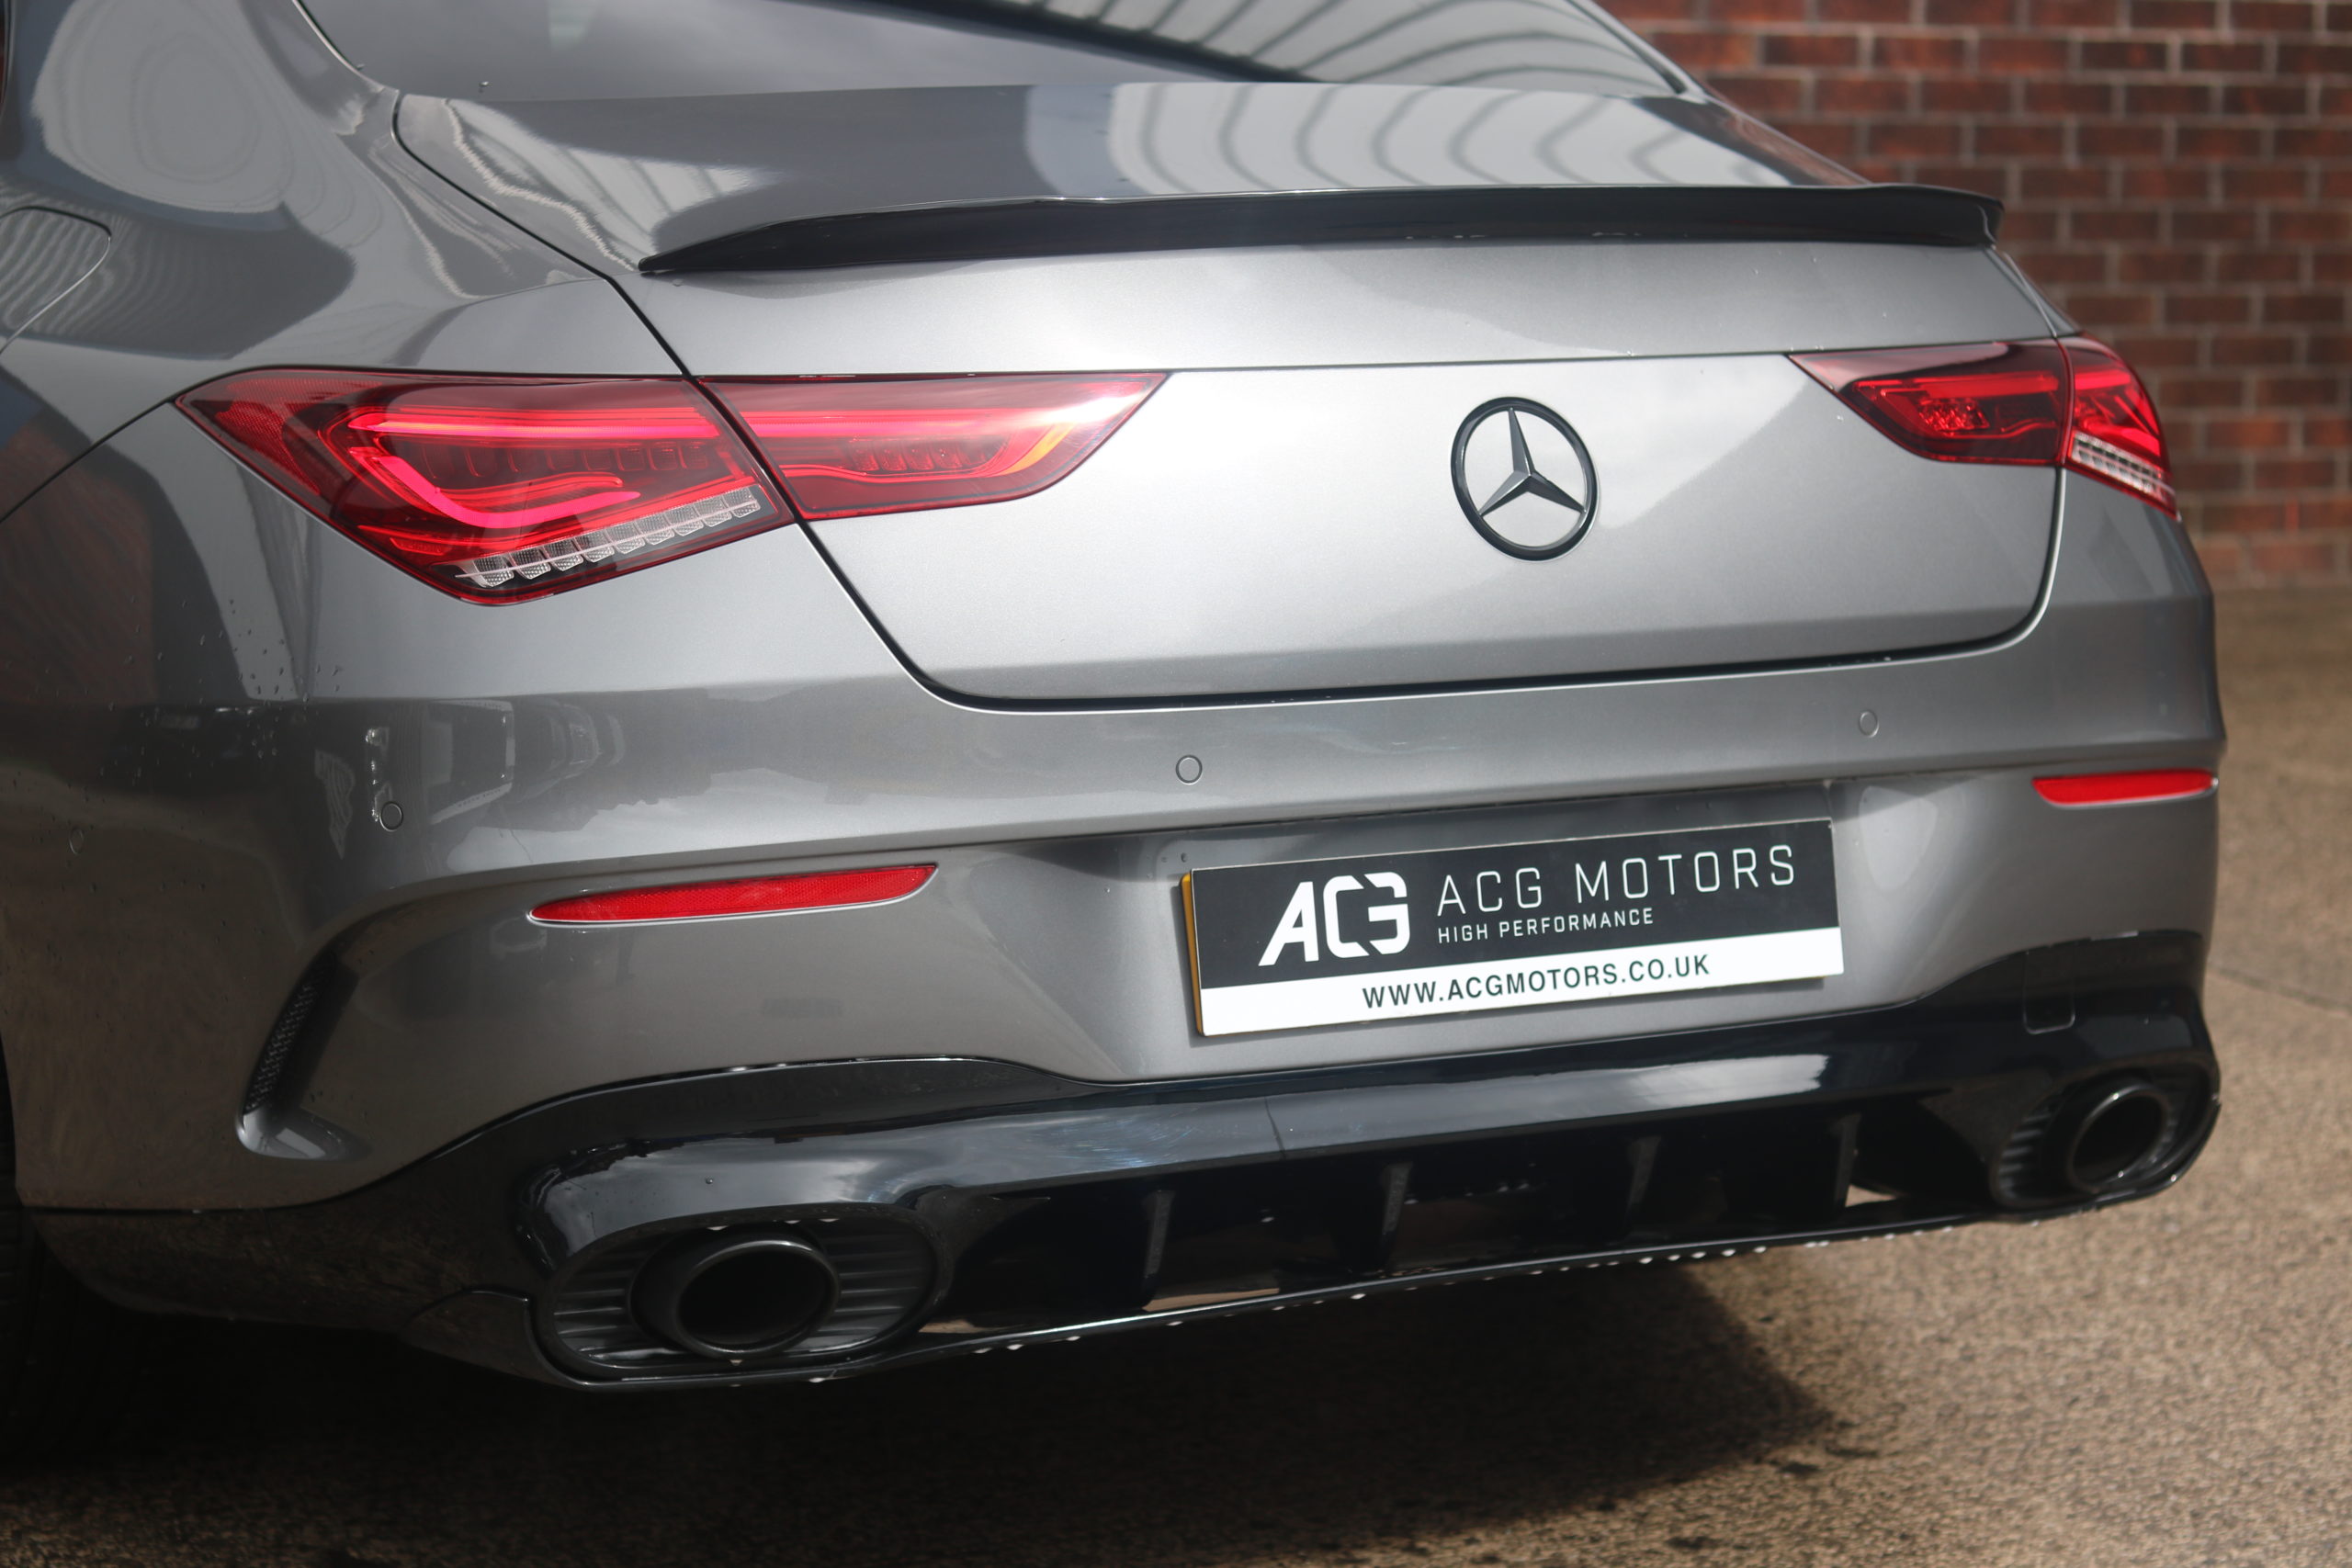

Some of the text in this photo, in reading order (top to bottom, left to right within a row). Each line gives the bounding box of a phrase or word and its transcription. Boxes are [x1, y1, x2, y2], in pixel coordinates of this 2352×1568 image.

[1437, 844, 1795, 917] ACG MOTORS
[1258, 872, 1411, 967] ACG
[1438, 907, 1654, 944] HIGH PERFORMANCE
[1362, 954, 1710, 1009] WWW.ACGMOTORS.CO.UK
